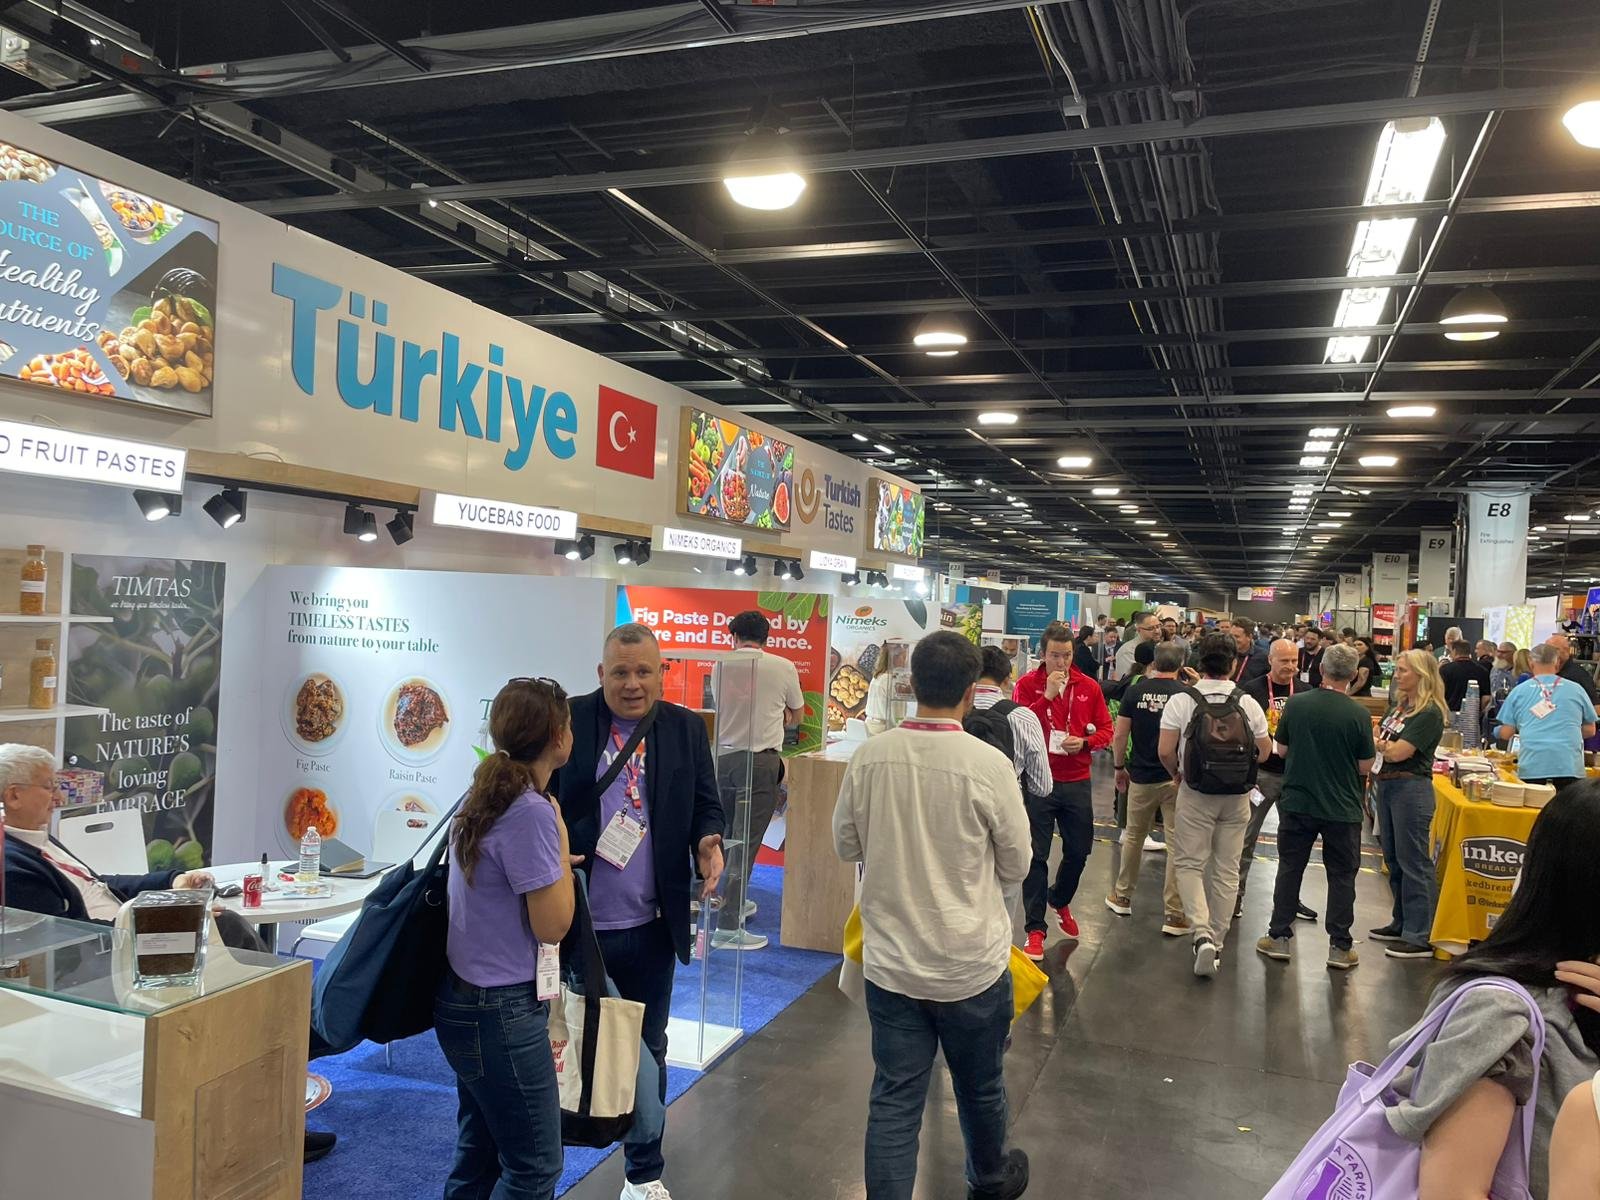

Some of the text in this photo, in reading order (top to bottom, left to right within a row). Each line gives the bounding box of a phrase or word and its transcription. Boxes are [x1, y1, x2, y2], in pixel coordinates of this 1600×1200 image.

[18, 201, 60, 228] THE
[67, 240, 94, 260] OF
[272, 262, 577, 471] Türkiye
[20, 438, 89, 465] FRUIT
[96, 449, 177, 478] PASTES
[824, 474, 861, 508] Turkish
[458, 502, 561, 531] YUCEBAS FOOD
[823, 503, 854, 533] Tastes
[1488, 503, 1511, 517] E8
[669, 532, 737, 554] NIMEKS ORGANICS
[1429, 538, 1445, 549] E9
[1384, 555, 1400, 563] E10
[112, 576, 192, 597] TIMTAS
[290, 591, 369, 612] We bring you
[288, 611, 410, 633] TIMELESS TASTES
[634, 608, 659, 625] Fig
[663, 610, 709, 626] Paste
[787, 615, 809, 634] by
[836, 615, 887, 627] Nimeks
[288, 629, 439, 653] from nature to your table
[675, 630, 707, 644] and
[98, 706, 193, 732] The taste of
[96, 734, 190, 762] NATURE'S
[296, 759, 331, 773] Fig Paste
[389, 768, 438, 784] Raisin Paste
[119, 768, 168, 789] loving
[96, 789, 186, 814] EMBRACE
[1475, 863, 1507, 872] BREAD
